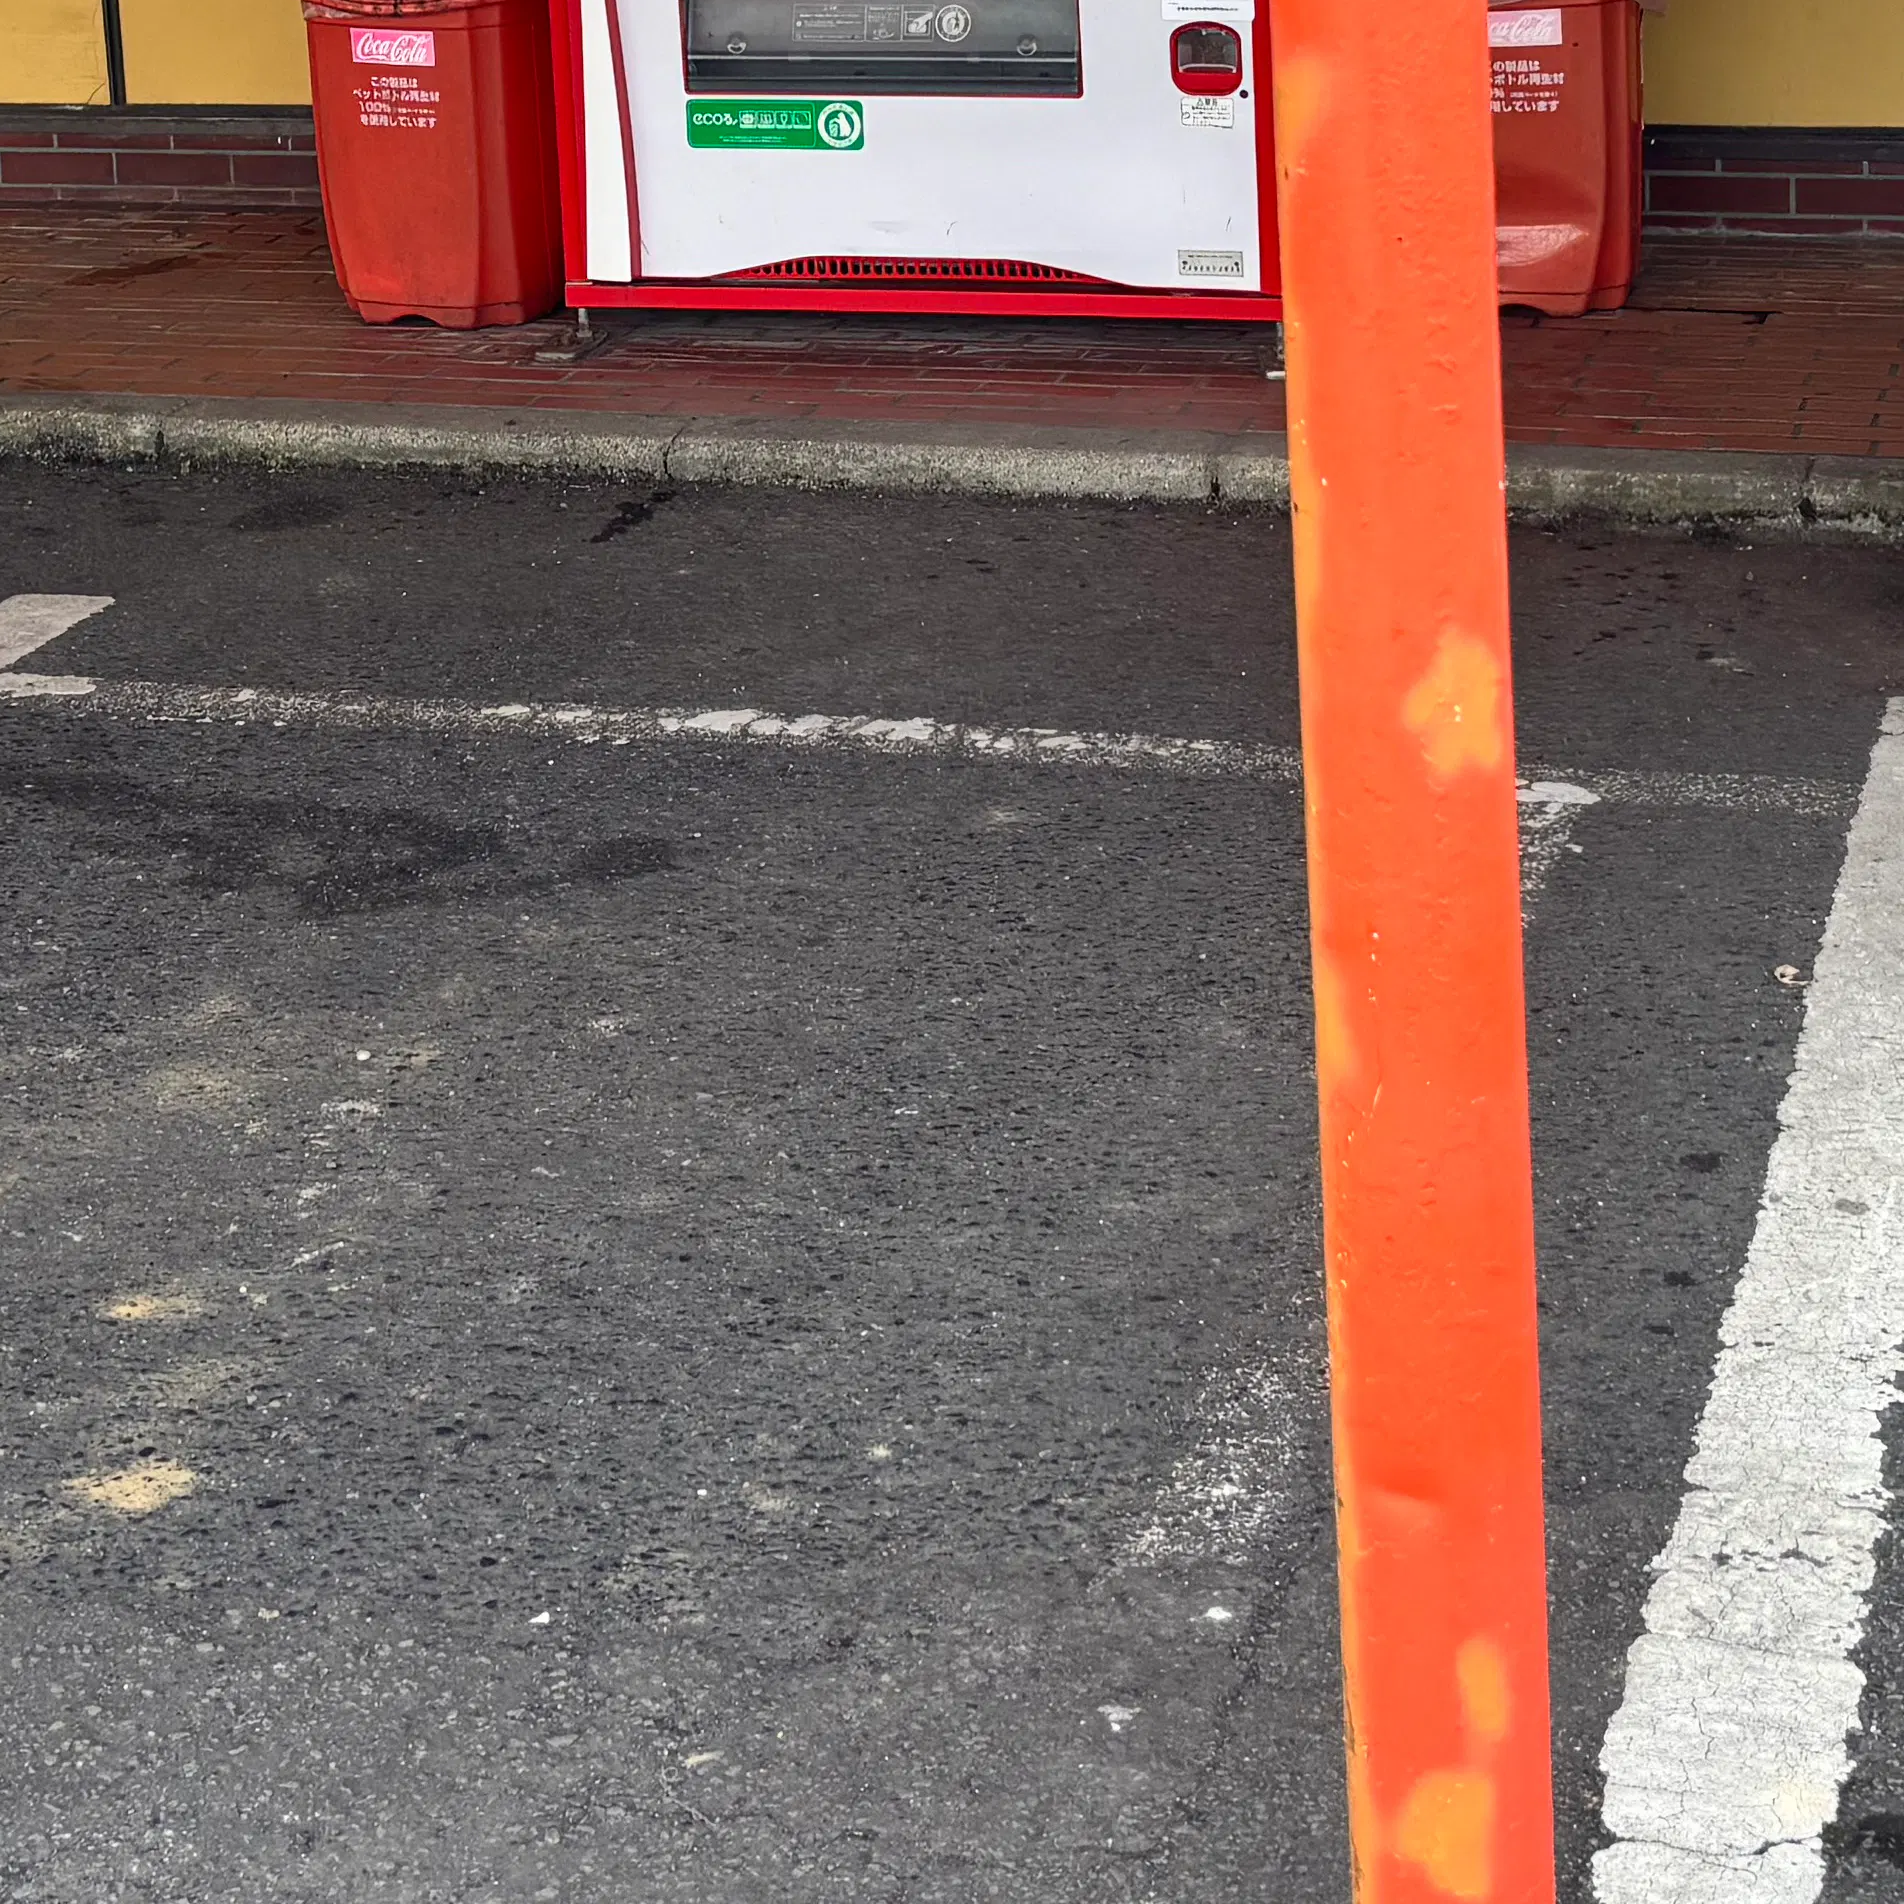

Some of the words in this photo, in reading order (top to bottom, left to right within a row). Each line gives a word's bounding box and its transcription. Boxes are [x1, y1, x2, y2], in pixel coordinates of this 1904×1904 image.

[356, 32, 432, 63] Coca-Cola
[1489, 60, 1541, 73] の製品は
